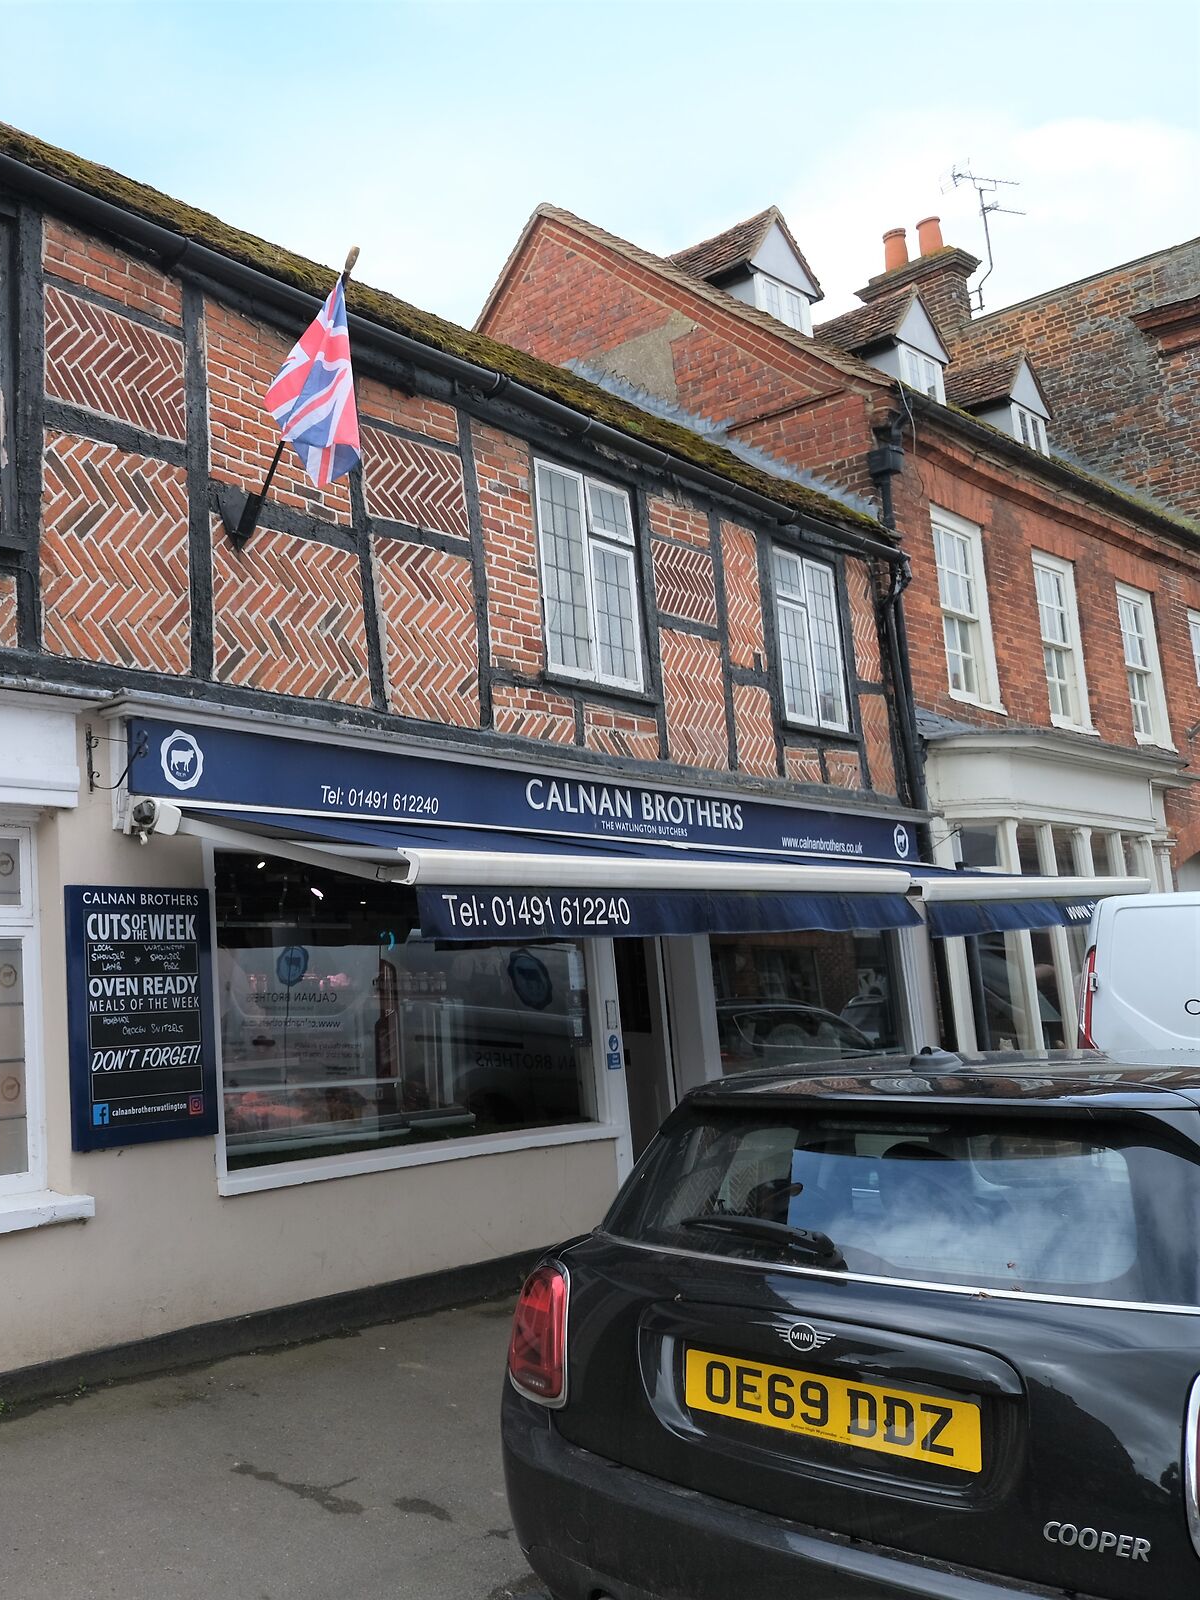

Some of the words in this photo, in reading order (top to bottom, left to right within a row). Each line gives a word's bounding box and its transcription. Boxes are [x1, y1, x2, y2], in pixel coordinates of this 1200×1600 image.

[320, 785, 344, 805] Tel:
[348, 788, 388, 809] 01491
[393, 793, 439, 815] 612240
[525, 778, 633, 819] CALNAN
[641, 791, 744, 831] BROTHERS
[601, 820, 615, 831] THE
[615, 821, 657, 835] WATLINGTON
[658, 825, 688, 837] BUTCHERS
[781, 836, 863, 854] www.calnanbrothers.co.uk
[82, 891, 136, 905] CALNAN
[140, 893, 199, 906] BROTHERS
[441, 894, 487, 927] Tel:
[491, 896, 555, 927] 01491
[560, 897, 630, 926] 612240
[86, 913, 132, 940] CUTS
[131, 914, 147, 930] OF
[147, 914, 197, 940] WEEK
[132, 929, 148, 940] THE
[88, 977, 139, 997] OVEN
[143, 975, 199, 996] READY
[89, 998, 126, 1013] MEALS
[130, 998, 144, 1011] OF
[148, 997, 168, 1010] THE
[171, 996, 200, 1009] WEEK
[91, 1048, 140, 1072] DON'T
[141, 1044, 201, 1068] FORGET!
[111, 1102, 187, 1117] calnanbrotherswatlington
[790, 1331, 813, 1343] MINI
[705, 1360, 829, 1427] OE69
[846, 1387, 954, 1457] DDZ
[1043, 1521, 1151, 1562] COOPER
